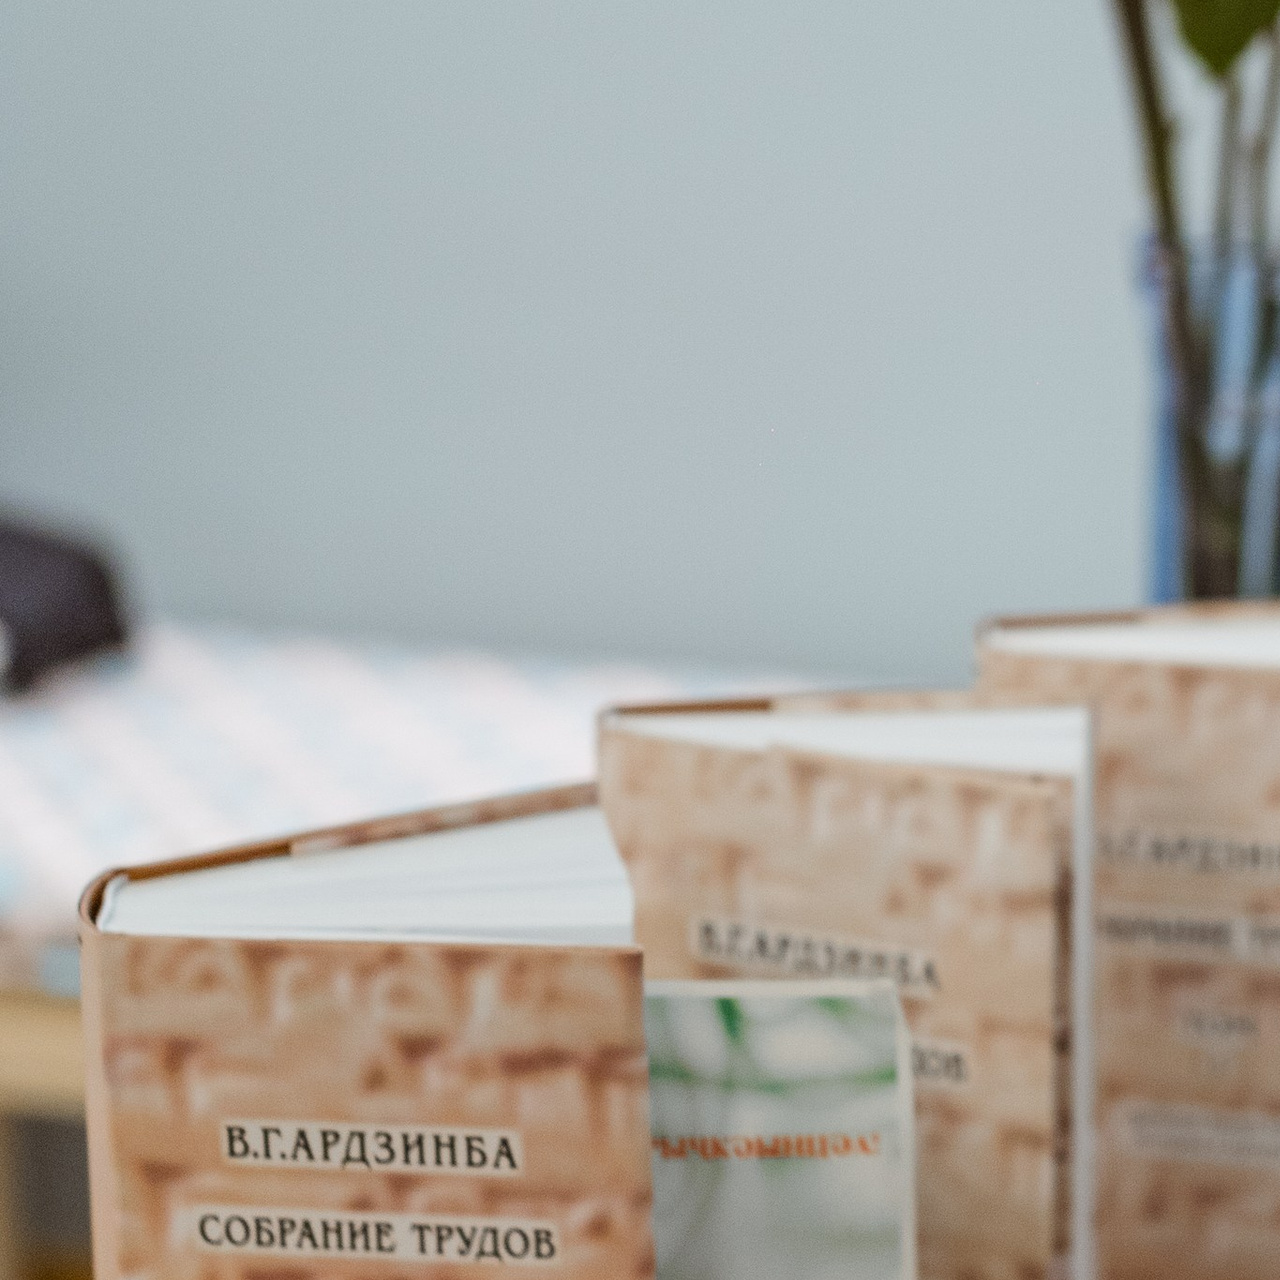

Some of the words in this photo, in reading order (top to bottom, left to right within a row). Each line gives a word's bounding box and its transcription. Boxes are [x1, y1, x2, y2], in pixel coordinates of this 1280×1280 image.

[224, 1124, 519, 1172] В.Г.АРДЗИНБА
[198, 1214, 397, 1254] СОБРАНИЕ
[410, 1222, 558, 1262] ТРУДОВ
